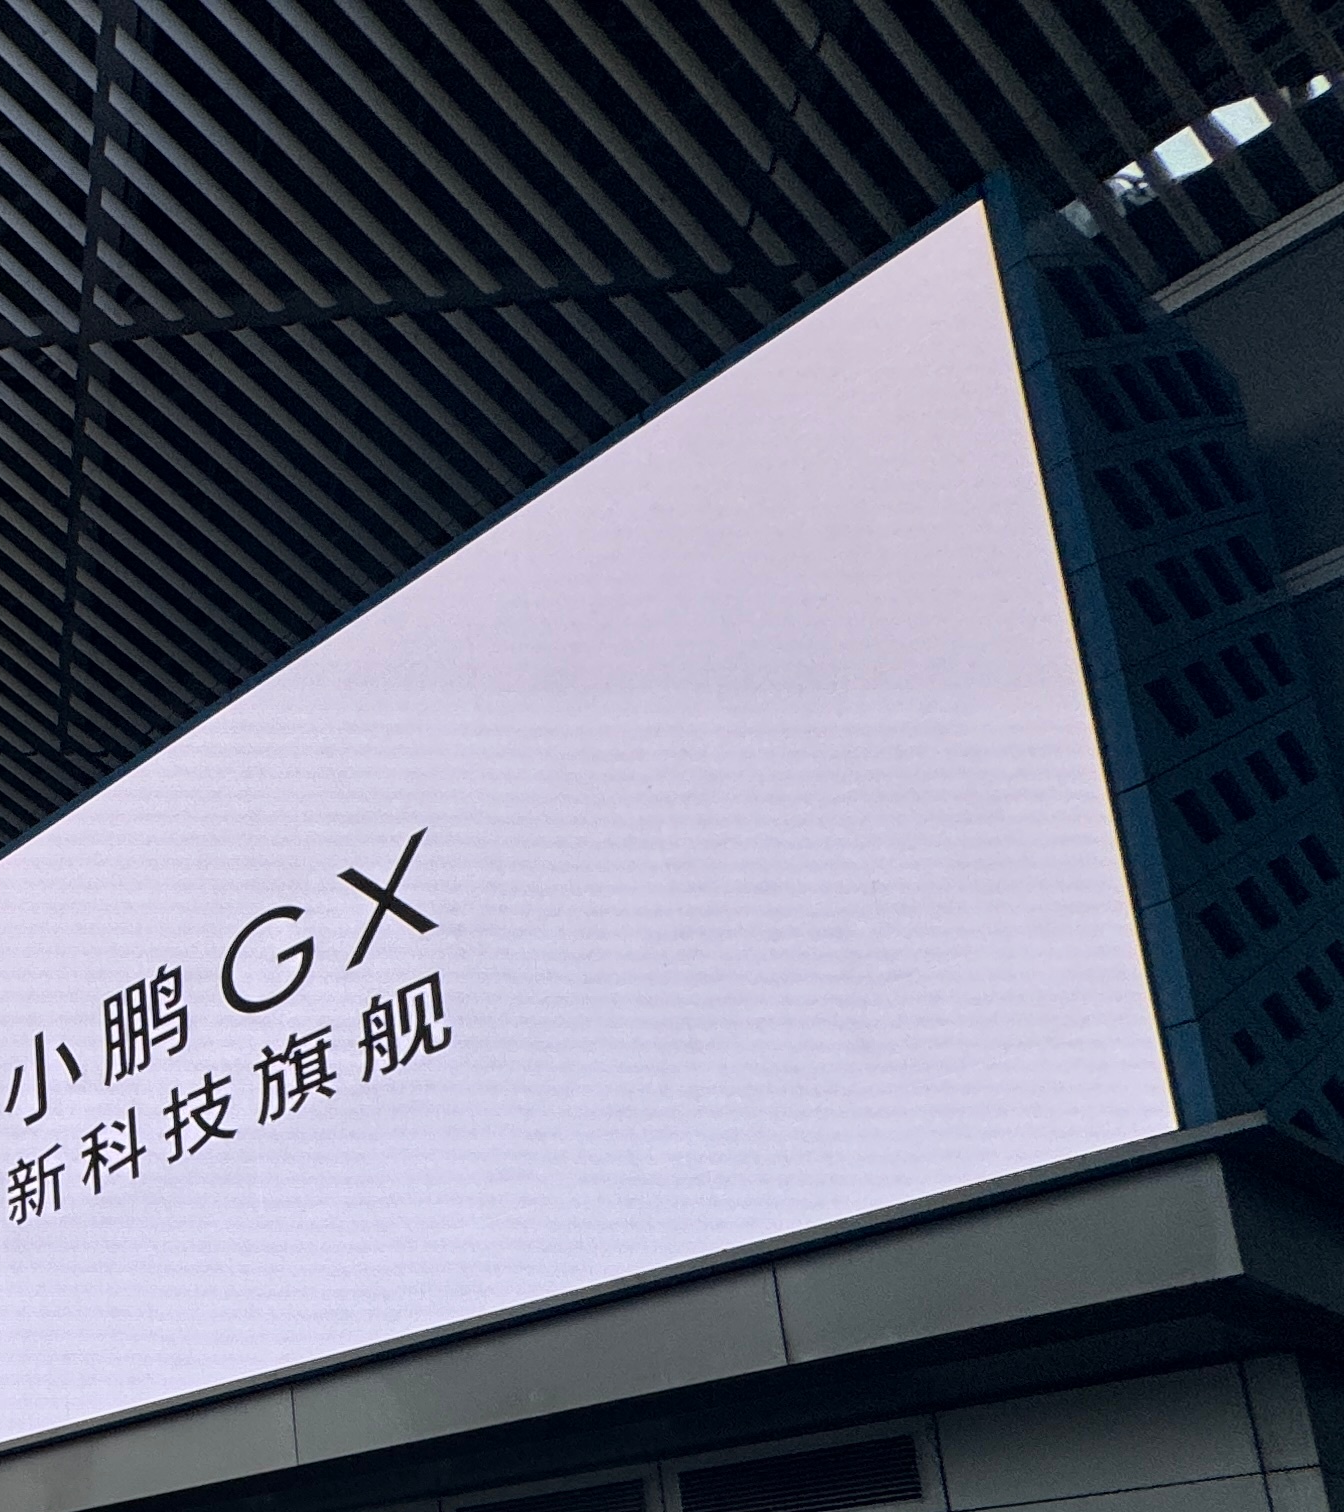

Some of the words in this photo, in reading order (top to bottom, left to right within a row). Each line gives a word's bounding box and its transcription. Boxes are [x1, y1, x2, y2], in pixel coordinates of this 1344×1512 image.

[4, 963, 190, 1126] 小鹏
[220, 826, 440, 1014] GX
[7, 971, 453, 1226] 新科技旗舰
